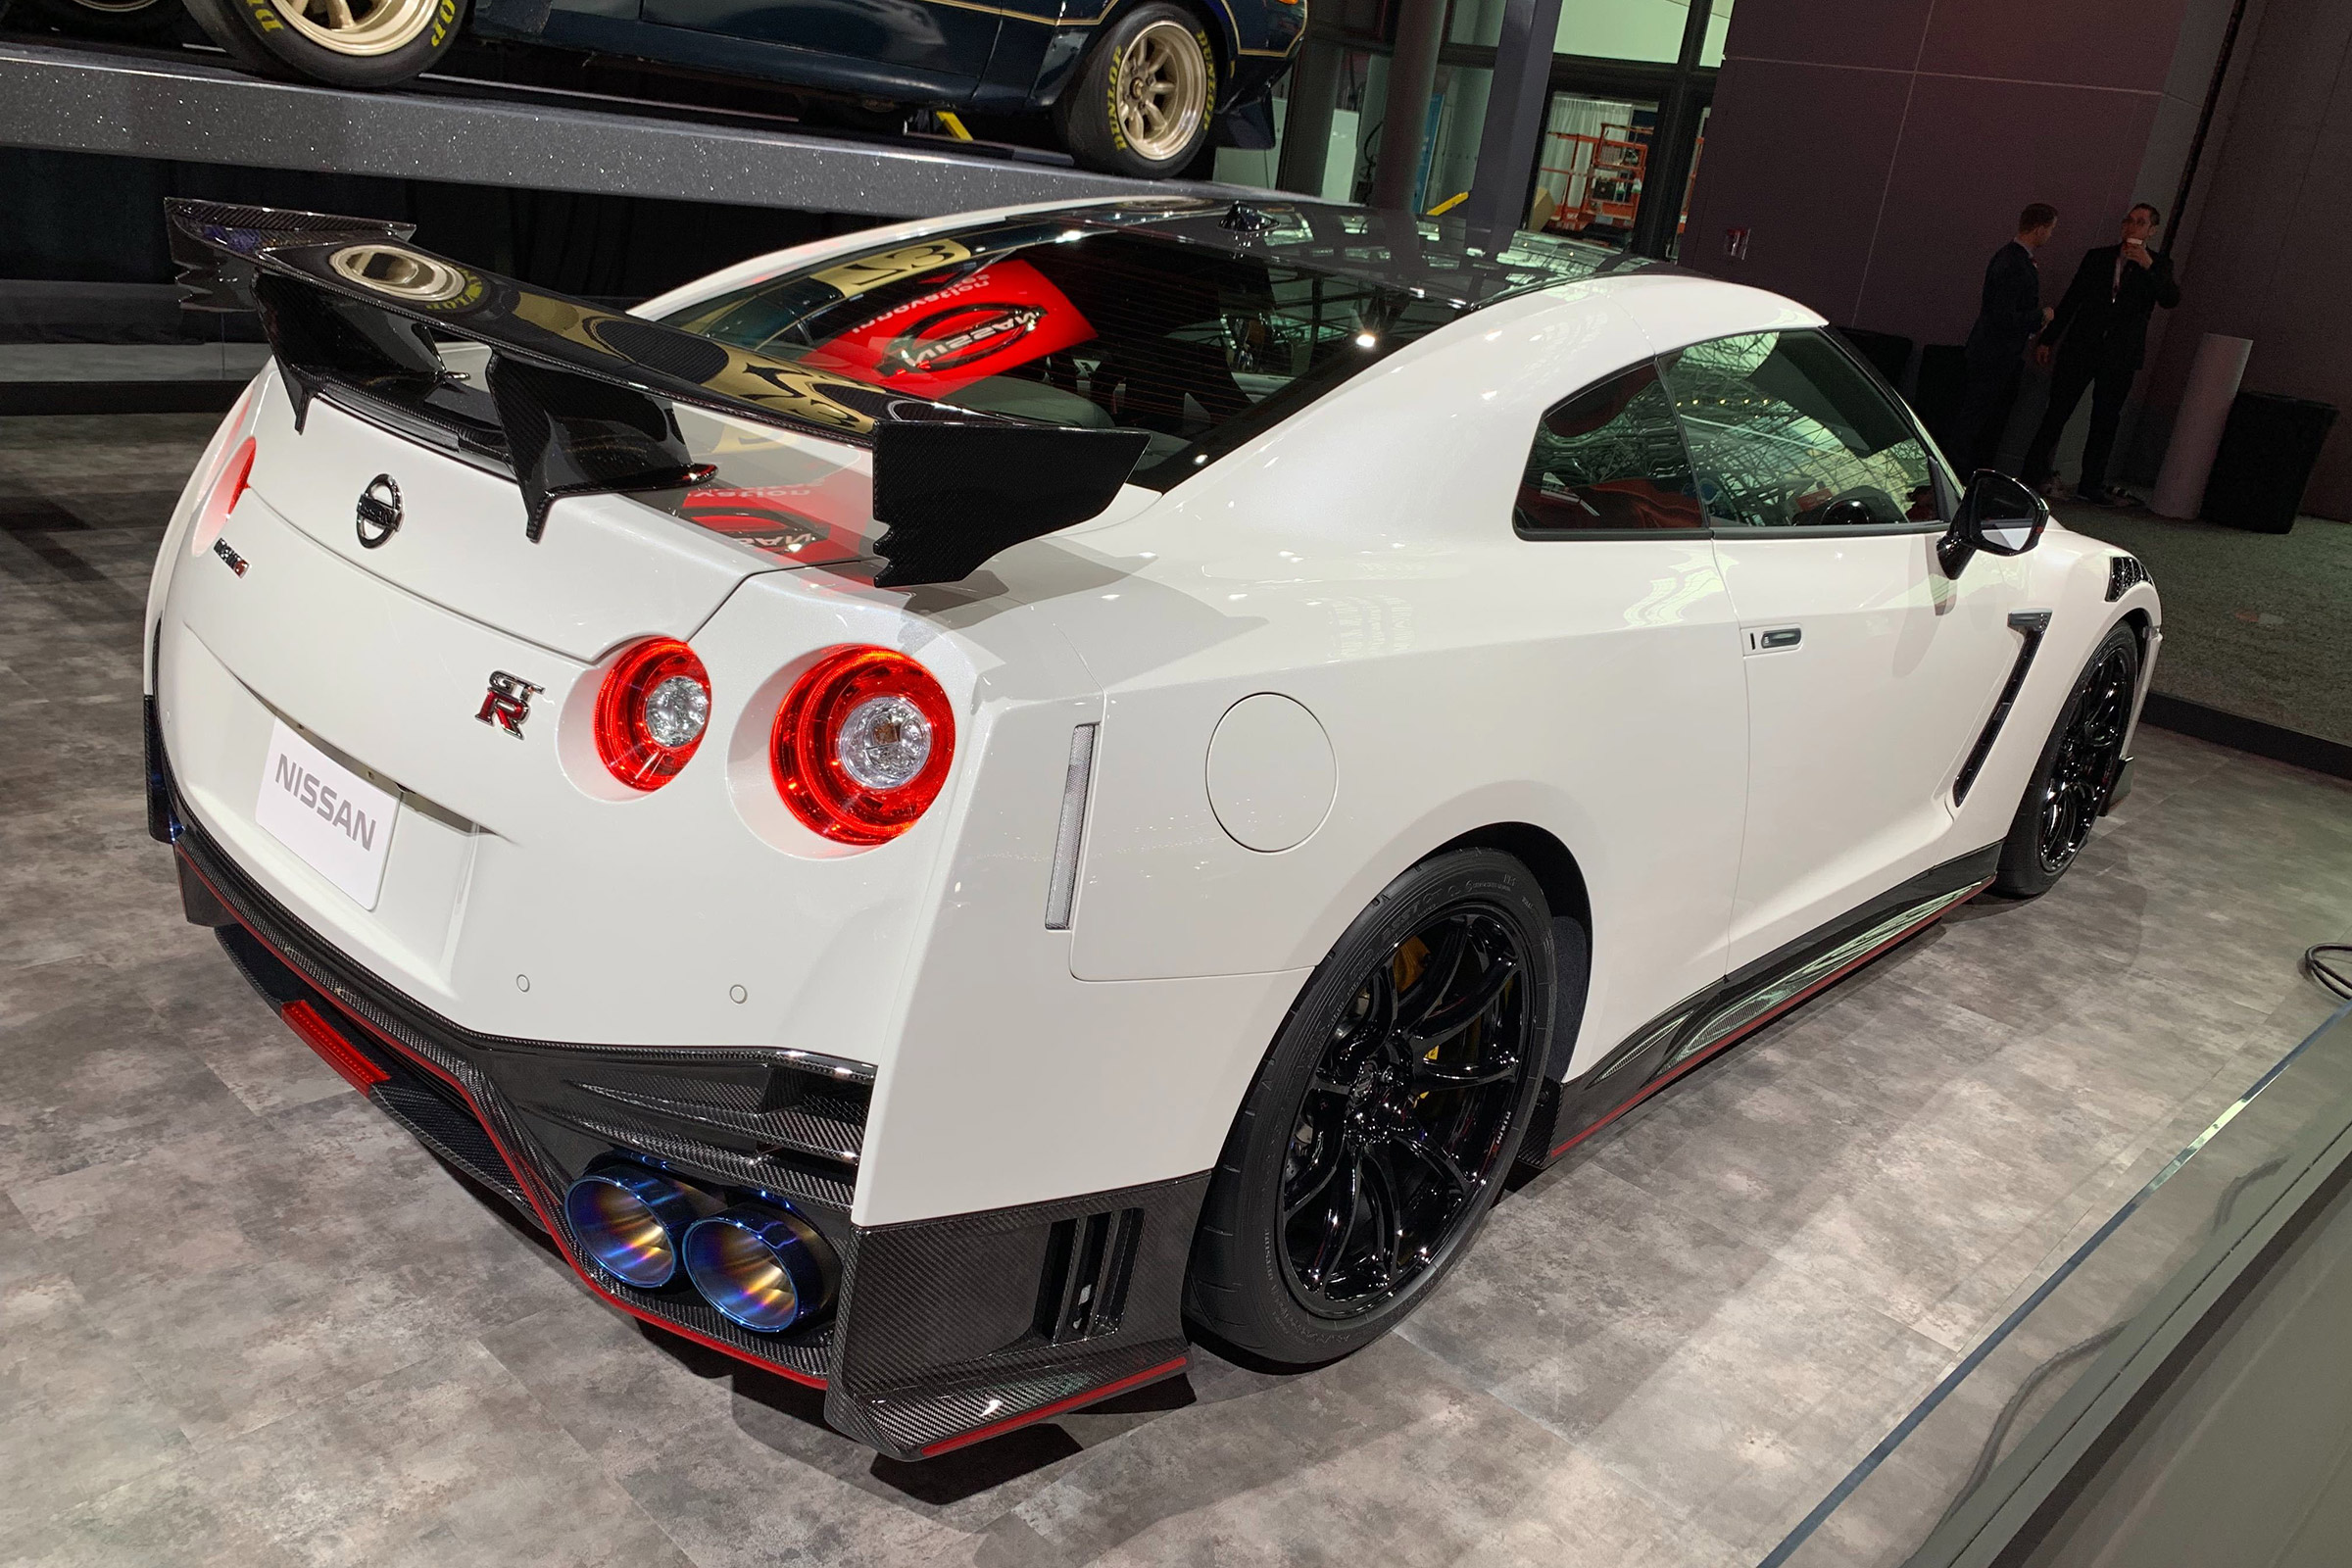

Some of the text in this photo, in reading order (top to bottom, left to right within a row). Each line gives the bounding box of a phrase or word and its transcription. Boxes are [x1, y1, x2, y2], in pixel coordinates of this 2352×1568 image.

[1107, 45, 1127, 150] DUNLOP
[1197, 29, 1216, 131] DUNLOP
[274, 753, 377, 853] NISSAN
